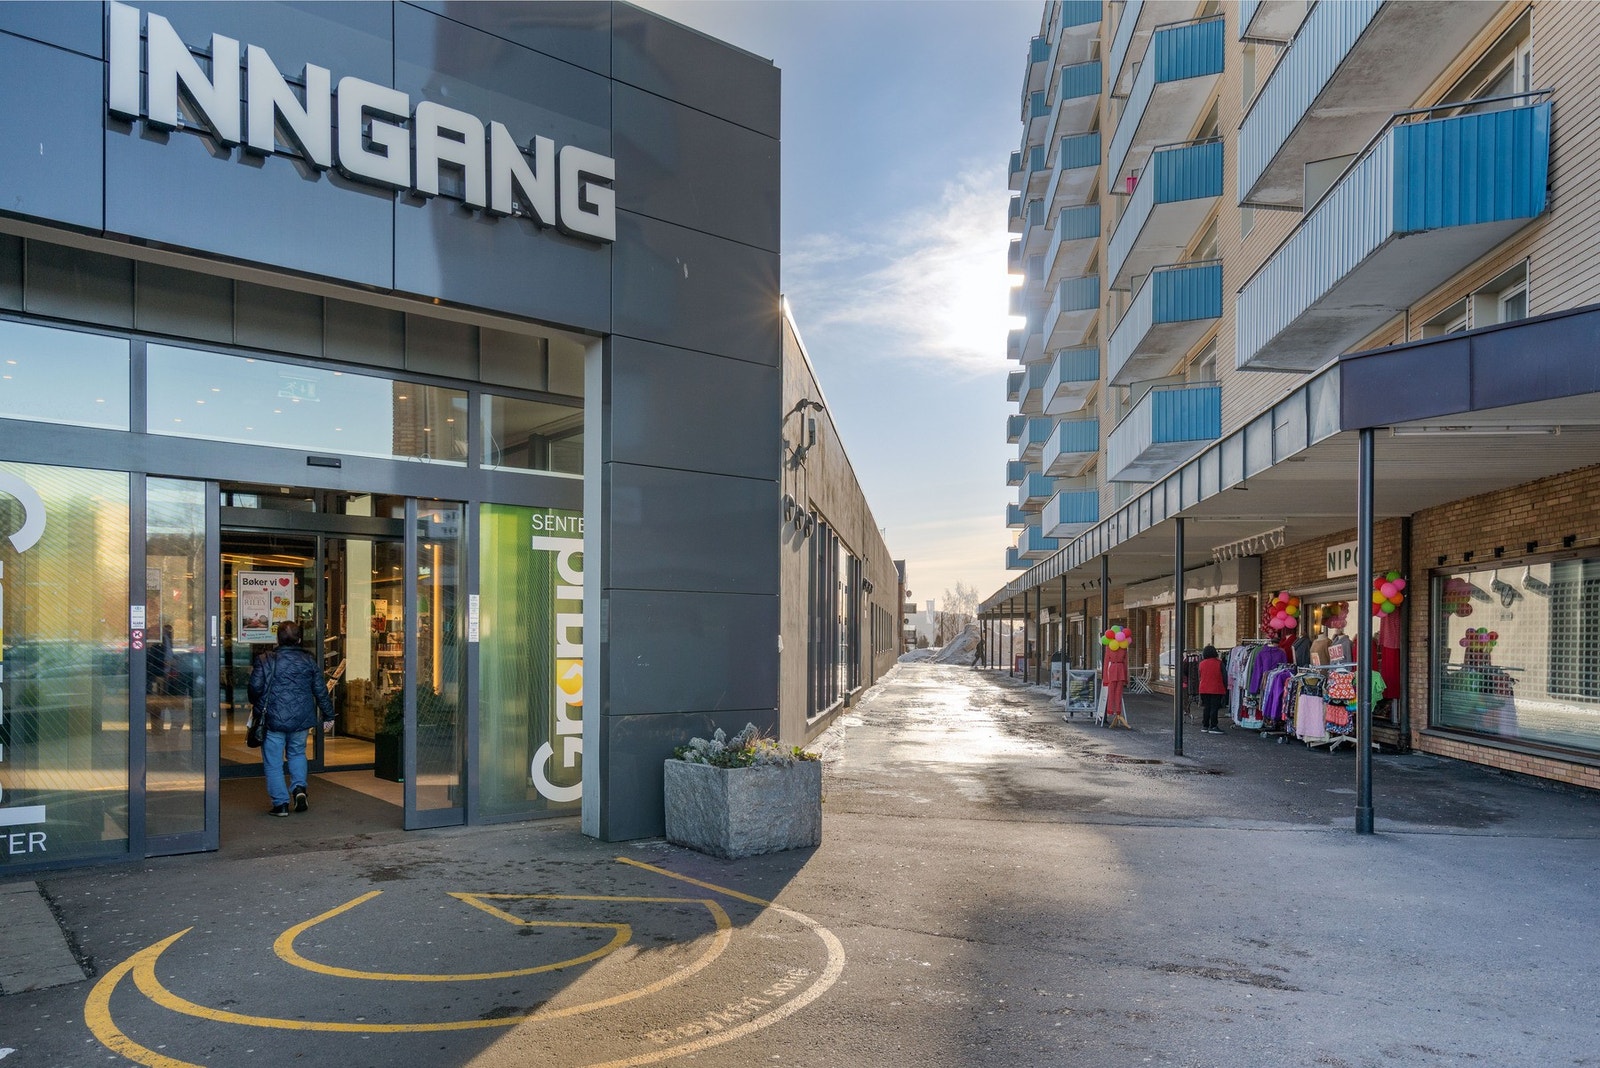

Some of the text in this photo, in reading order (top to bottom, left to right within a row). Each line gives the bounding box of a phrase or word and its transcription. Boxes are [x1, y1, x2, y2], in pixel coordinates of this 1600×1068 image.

[109, 1, 616, 242] INNGANG
[242, 578, 277, 586] Bøker vi
